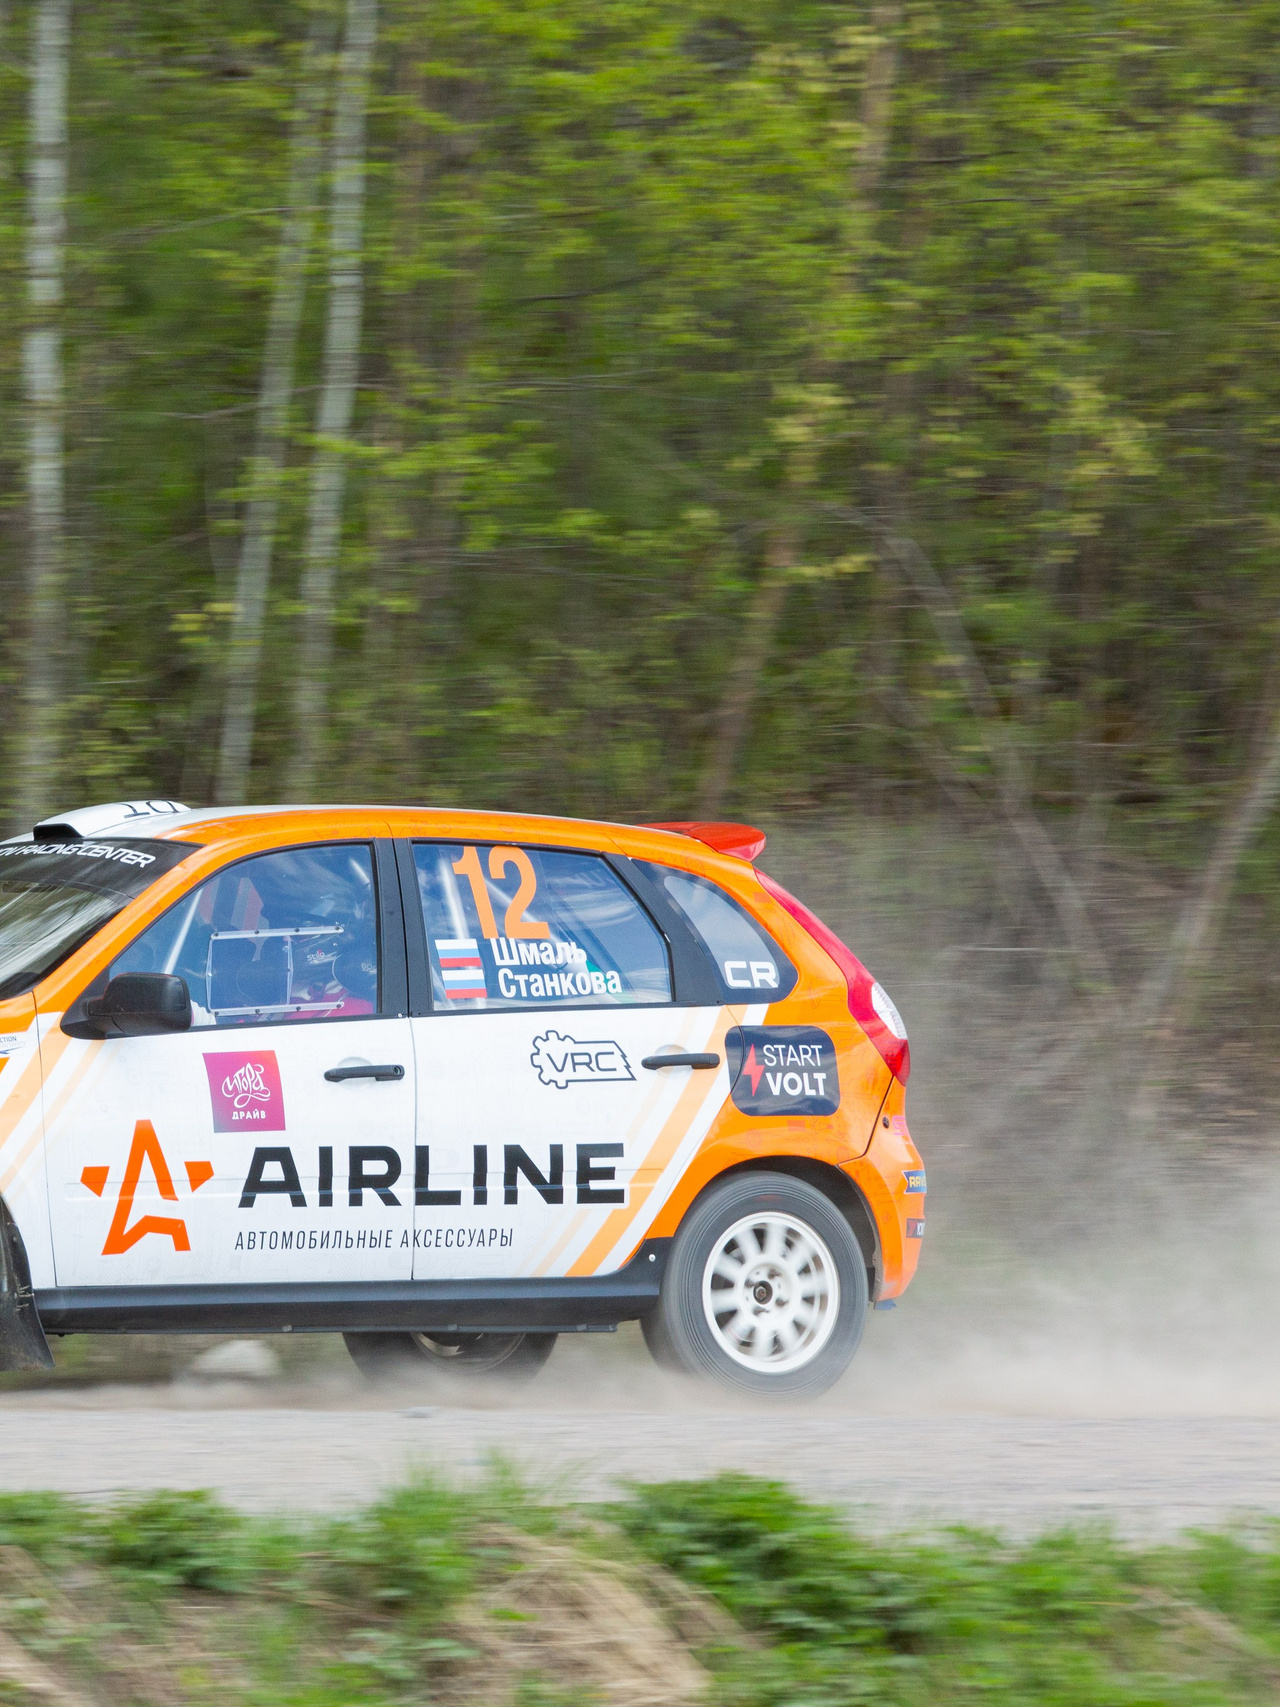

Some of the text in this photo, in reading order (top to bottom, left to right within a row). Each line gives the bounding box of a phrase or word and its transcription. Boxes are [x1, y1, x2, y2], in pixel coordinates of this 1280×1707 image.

[77, 844, 157, 868] CENTER
[452, 846, 551, 939] 12
[490, 937, 587, 966] Шмаль
[498, 968, 622, 998] Станкова
[724, 960, 779, 988] CR
[546, 1051, 617, 1073] VRC
[763, 1044, 823, 1067] START
[765, 1072, 827, 1096] VOLT
[231, 1108, 267, 1120] ДРАЙВ
[237, 1142, 625, 1208] AIRLINE
[234, 1227, 514, 1251] АВТОМОБИЛЬНЫЕ АКСЕССУАРЫ
